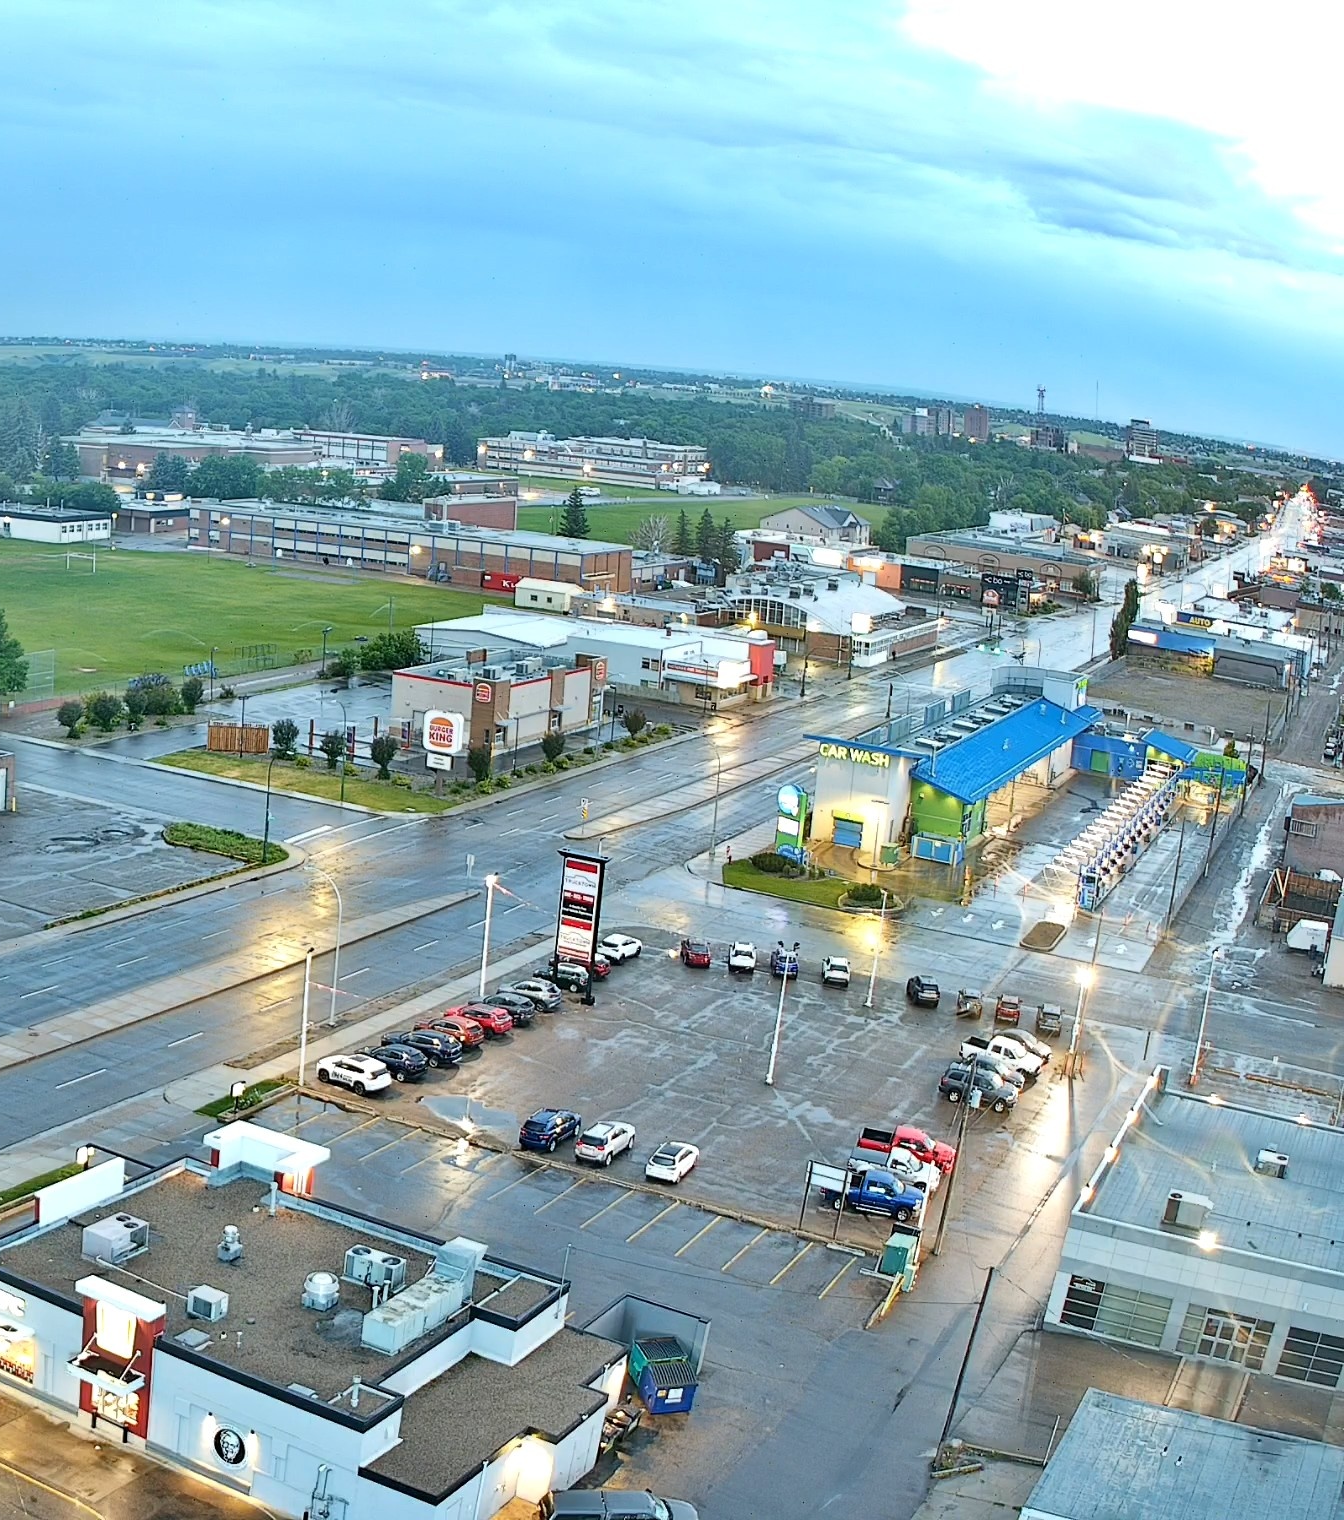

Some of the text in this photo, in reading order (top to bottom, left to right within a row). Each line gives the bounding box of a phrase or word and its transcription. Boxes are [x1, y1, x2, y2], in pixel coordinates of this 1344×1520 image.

[1188, 616, 1211, 627] AUTO
[429, 724, 454, 735] BURGER
[429, 731, 453, 743] KING
[819, 743, 890, 768] CAR WASH
